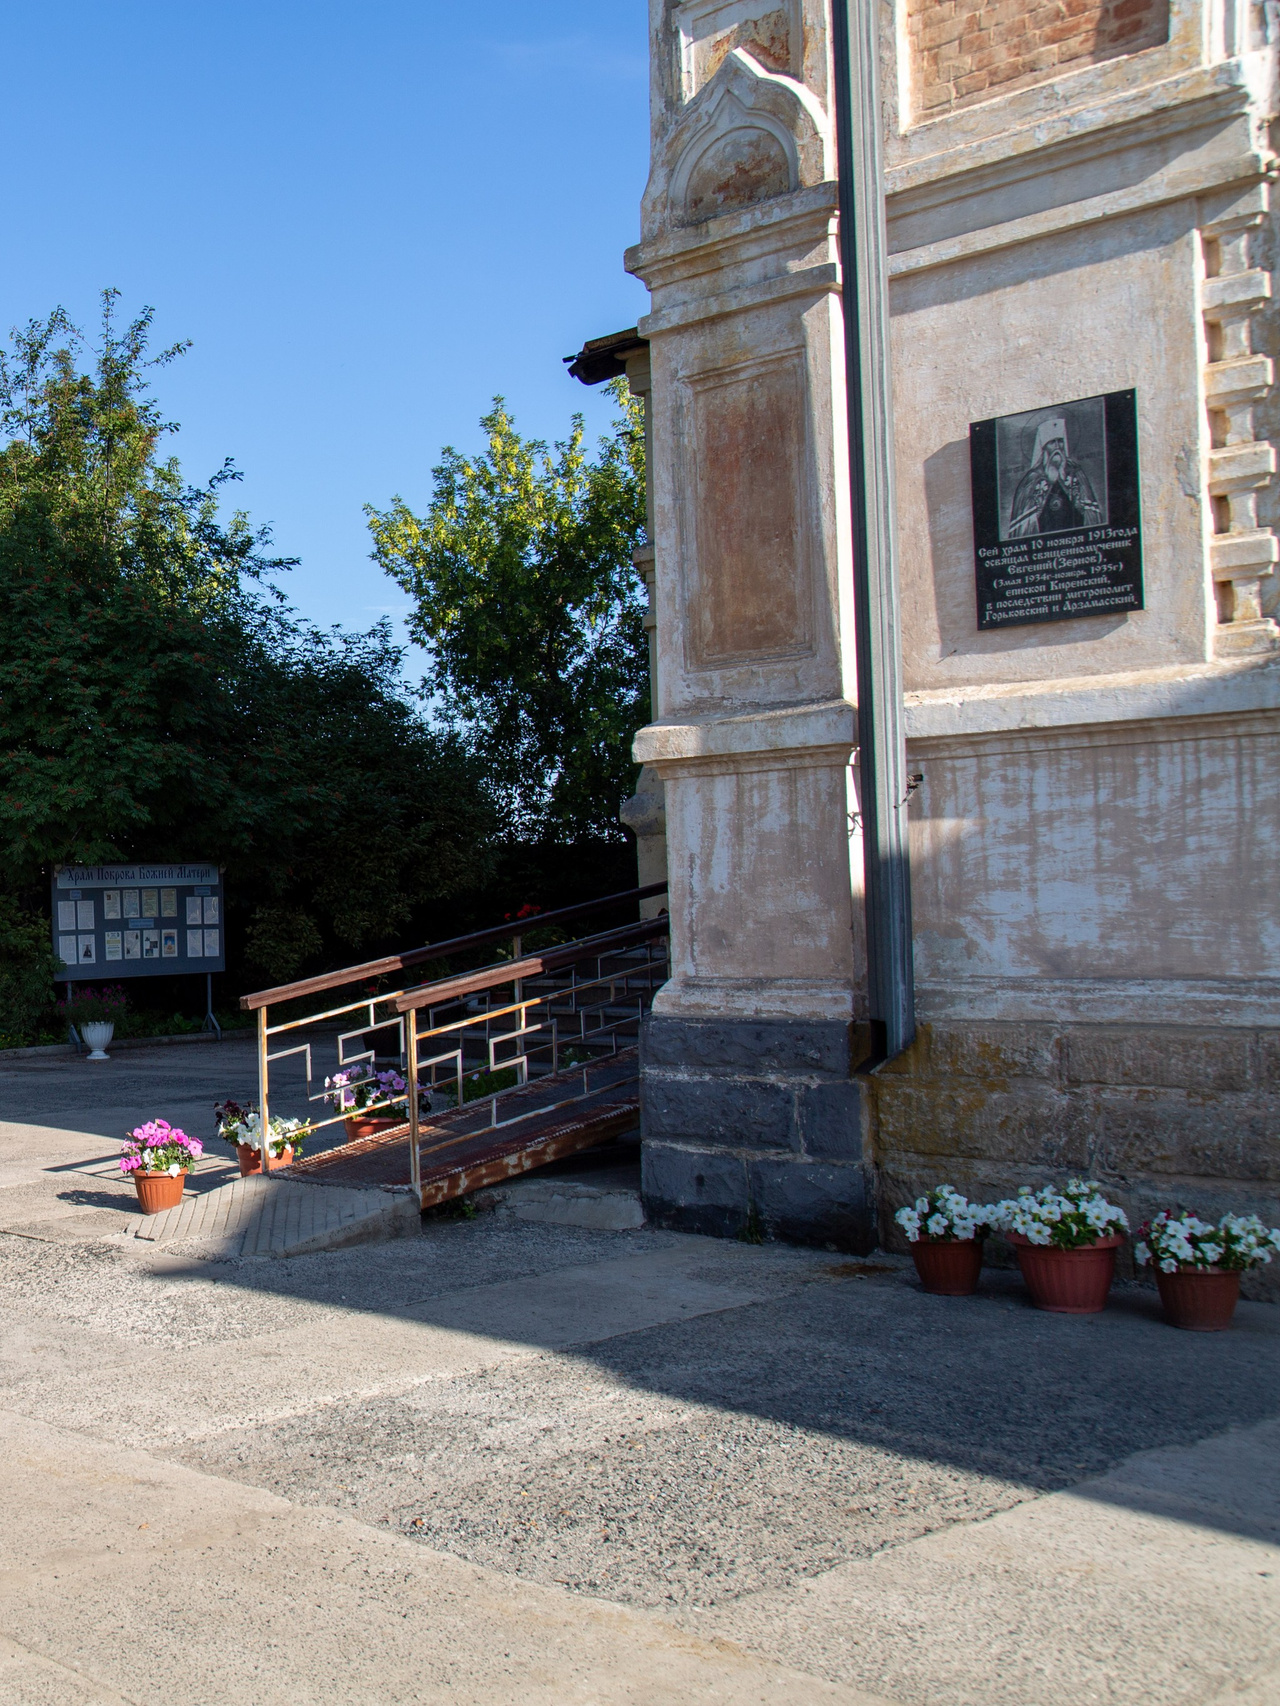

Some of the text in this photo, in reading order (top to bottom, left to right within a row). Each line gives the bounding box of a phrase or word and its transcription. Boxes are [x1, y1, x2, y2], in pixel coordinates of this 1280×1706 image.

[978, 527, 1138, 558] Сей храм 10 ноября 1913года
[984, 539, 1132, 568] освящал священномученик
[1090, 562, 1124, 575] 1935г)
[986, 583, 1134, 610] в последствии митрополит
[1005, 574, 1111, 597] епископ Киренский,
[985, 593, 1136, 622] Горьковский и Арзамасский
[67, 866, 211, 886] Храм Покрова Божией Матери
